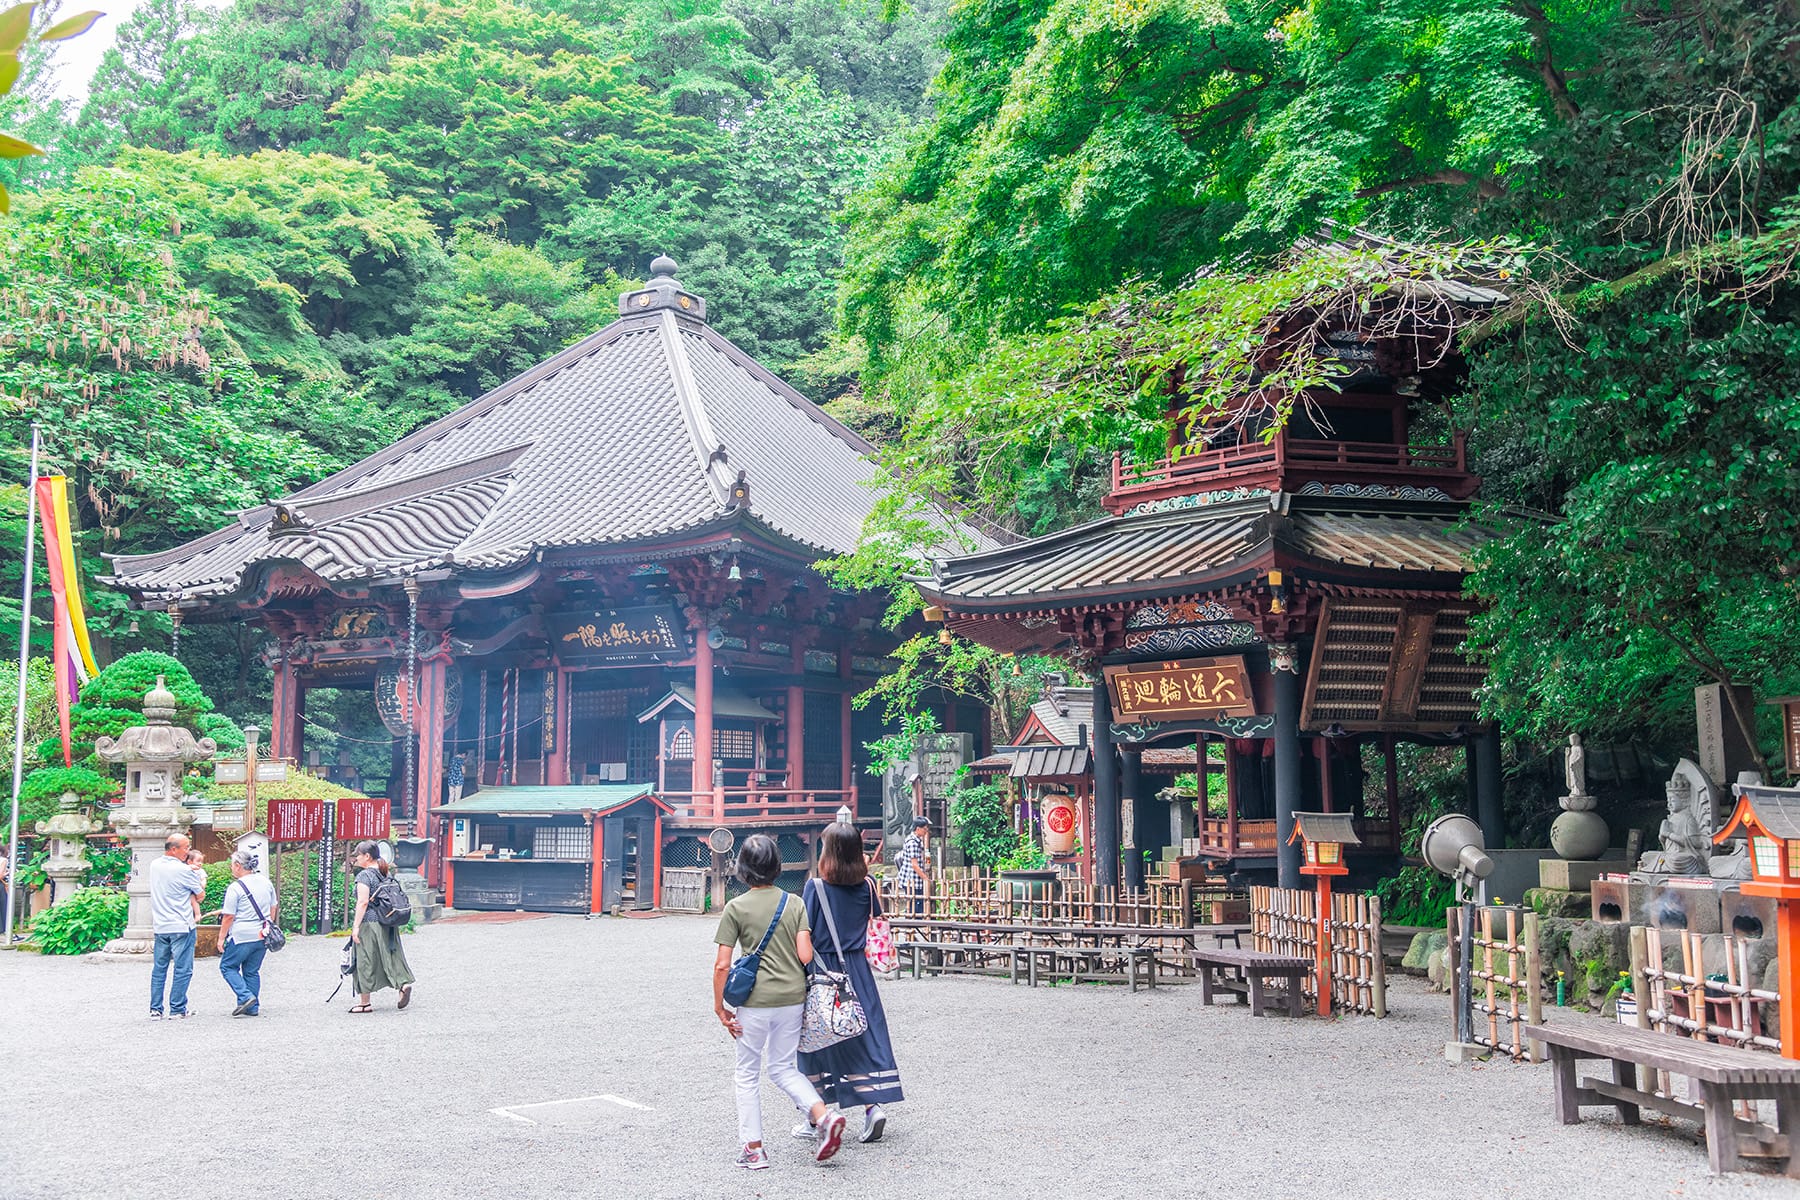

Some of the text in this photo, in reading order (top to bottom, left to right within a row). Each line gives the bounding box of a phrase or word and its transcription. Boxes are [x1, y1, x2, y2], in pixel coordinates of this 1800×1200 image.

[562, 622, 661, 648] 一隅を照らそう
